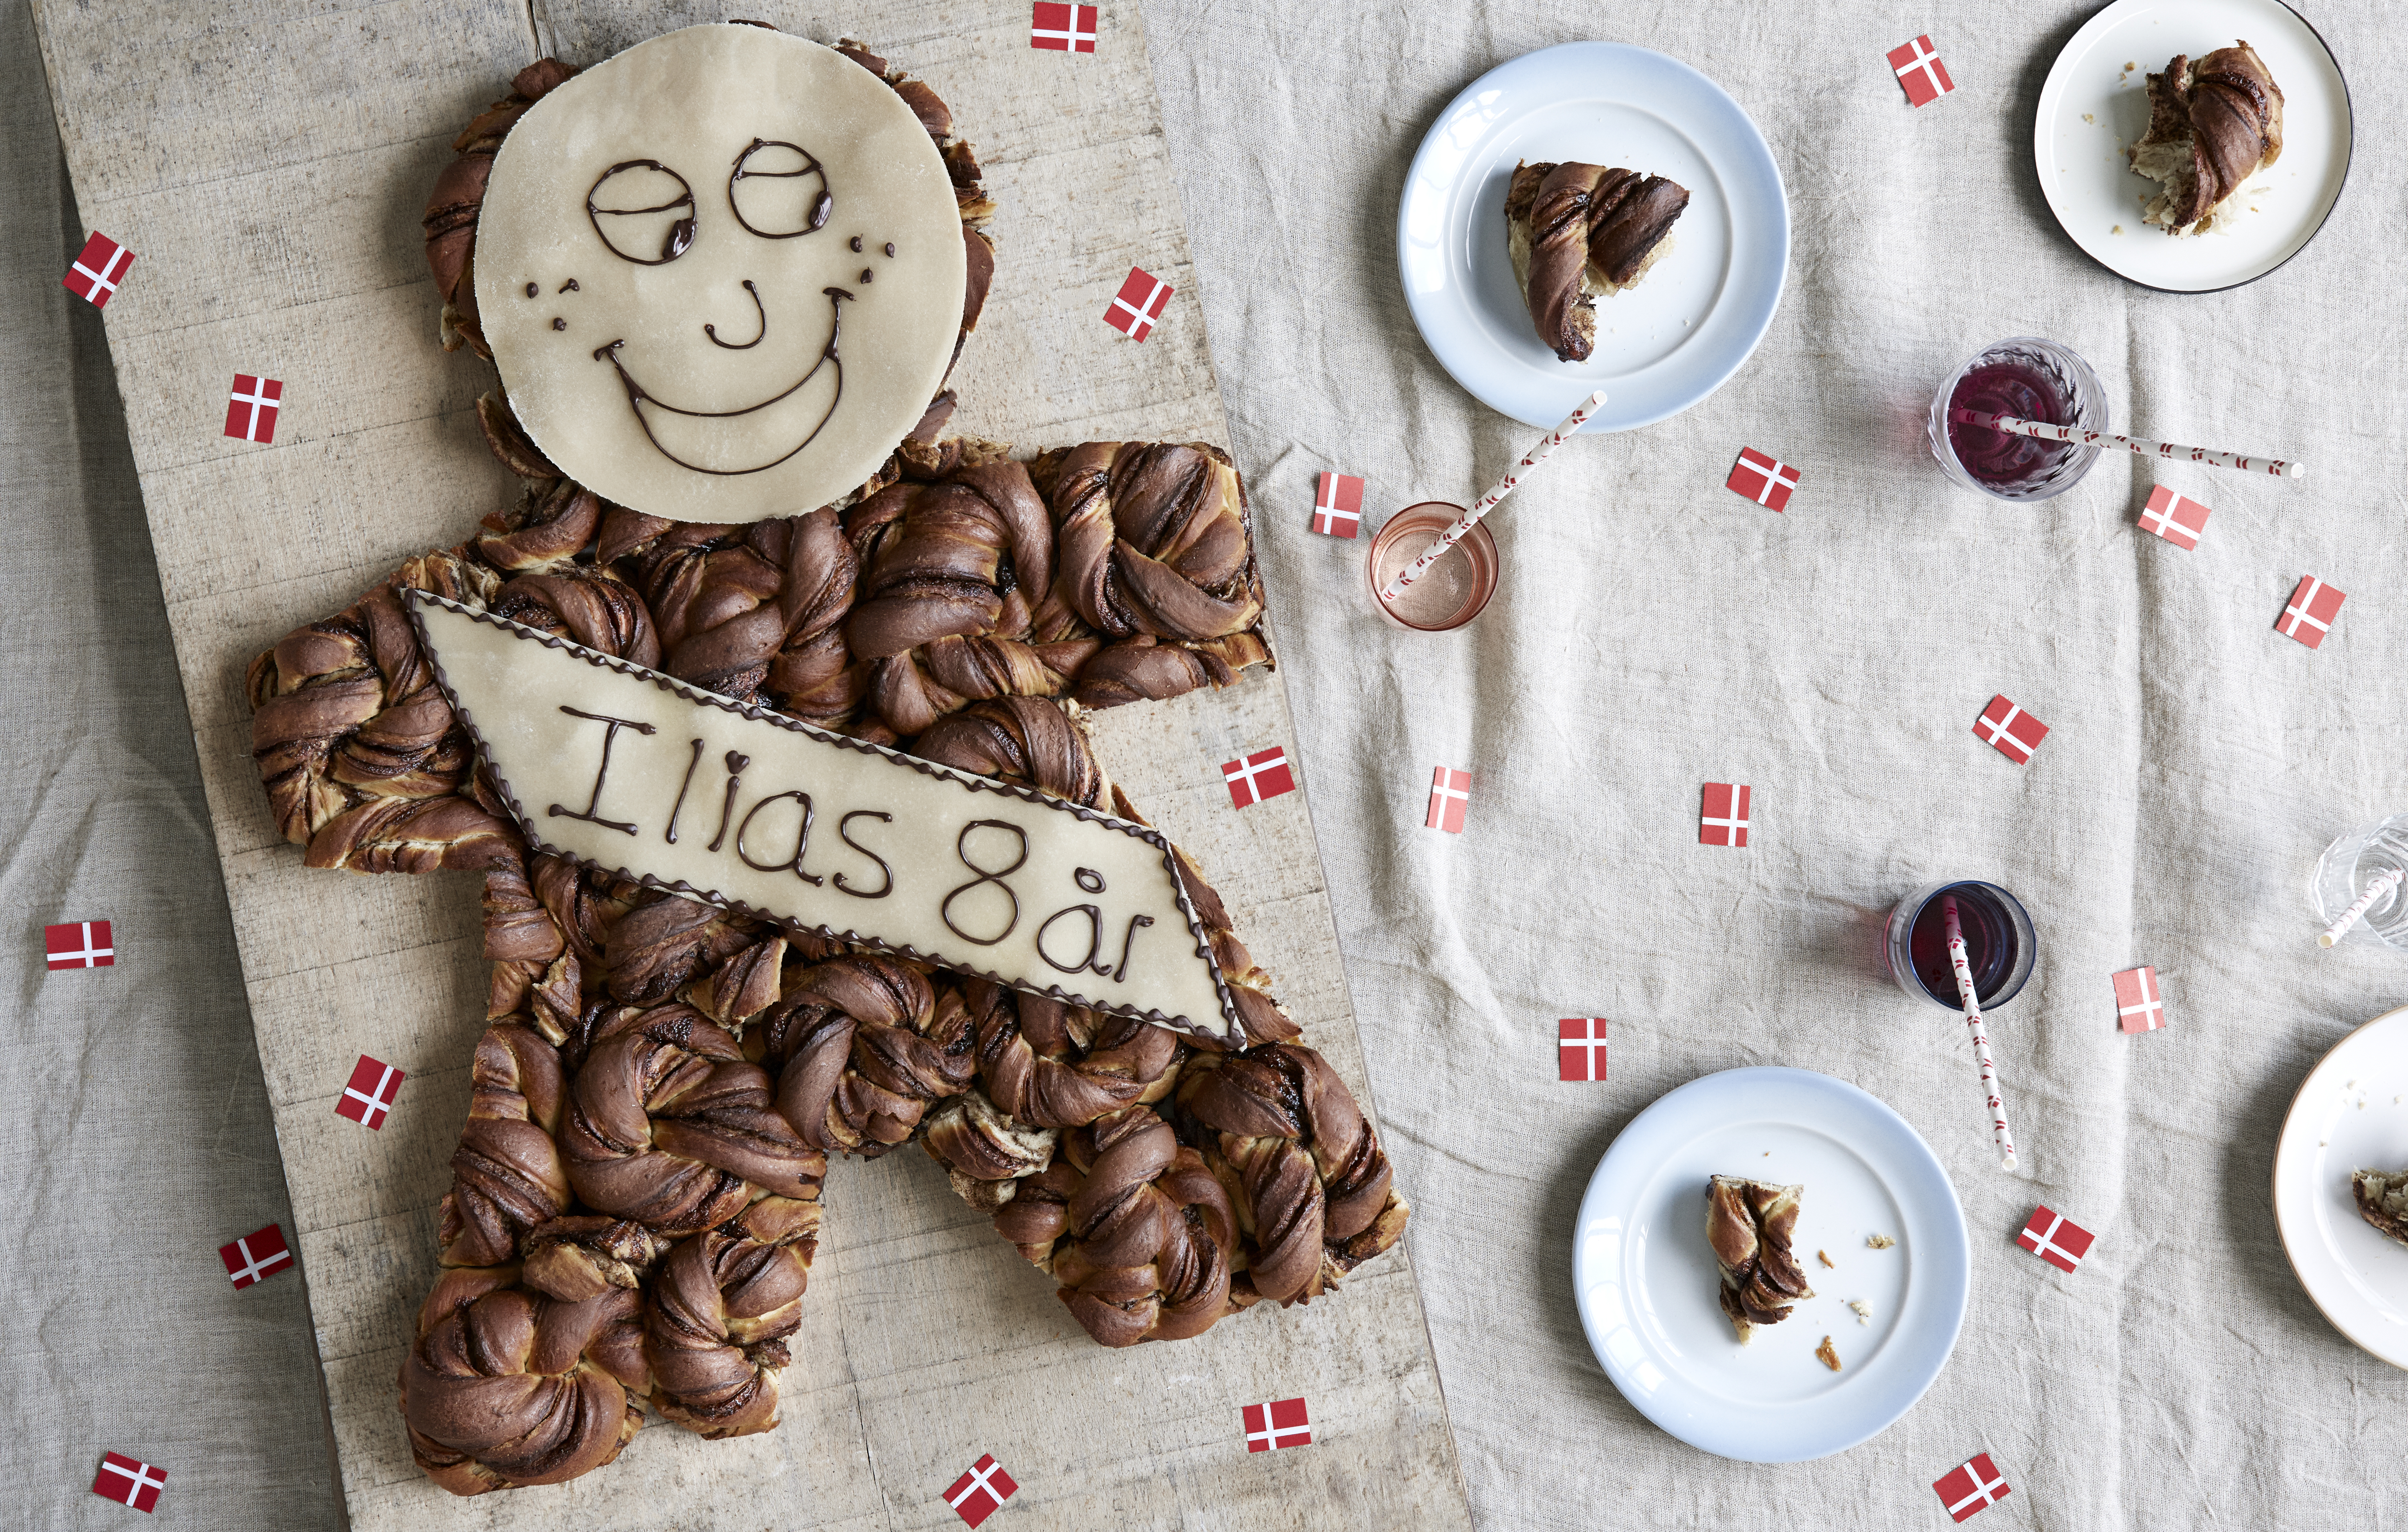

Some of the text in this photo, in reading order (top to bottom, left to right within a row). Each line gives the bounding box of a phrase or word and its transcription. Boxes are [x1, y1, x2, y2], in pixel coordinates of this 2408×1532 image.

[548, 706, 1156, 983] Ilias 8 år
